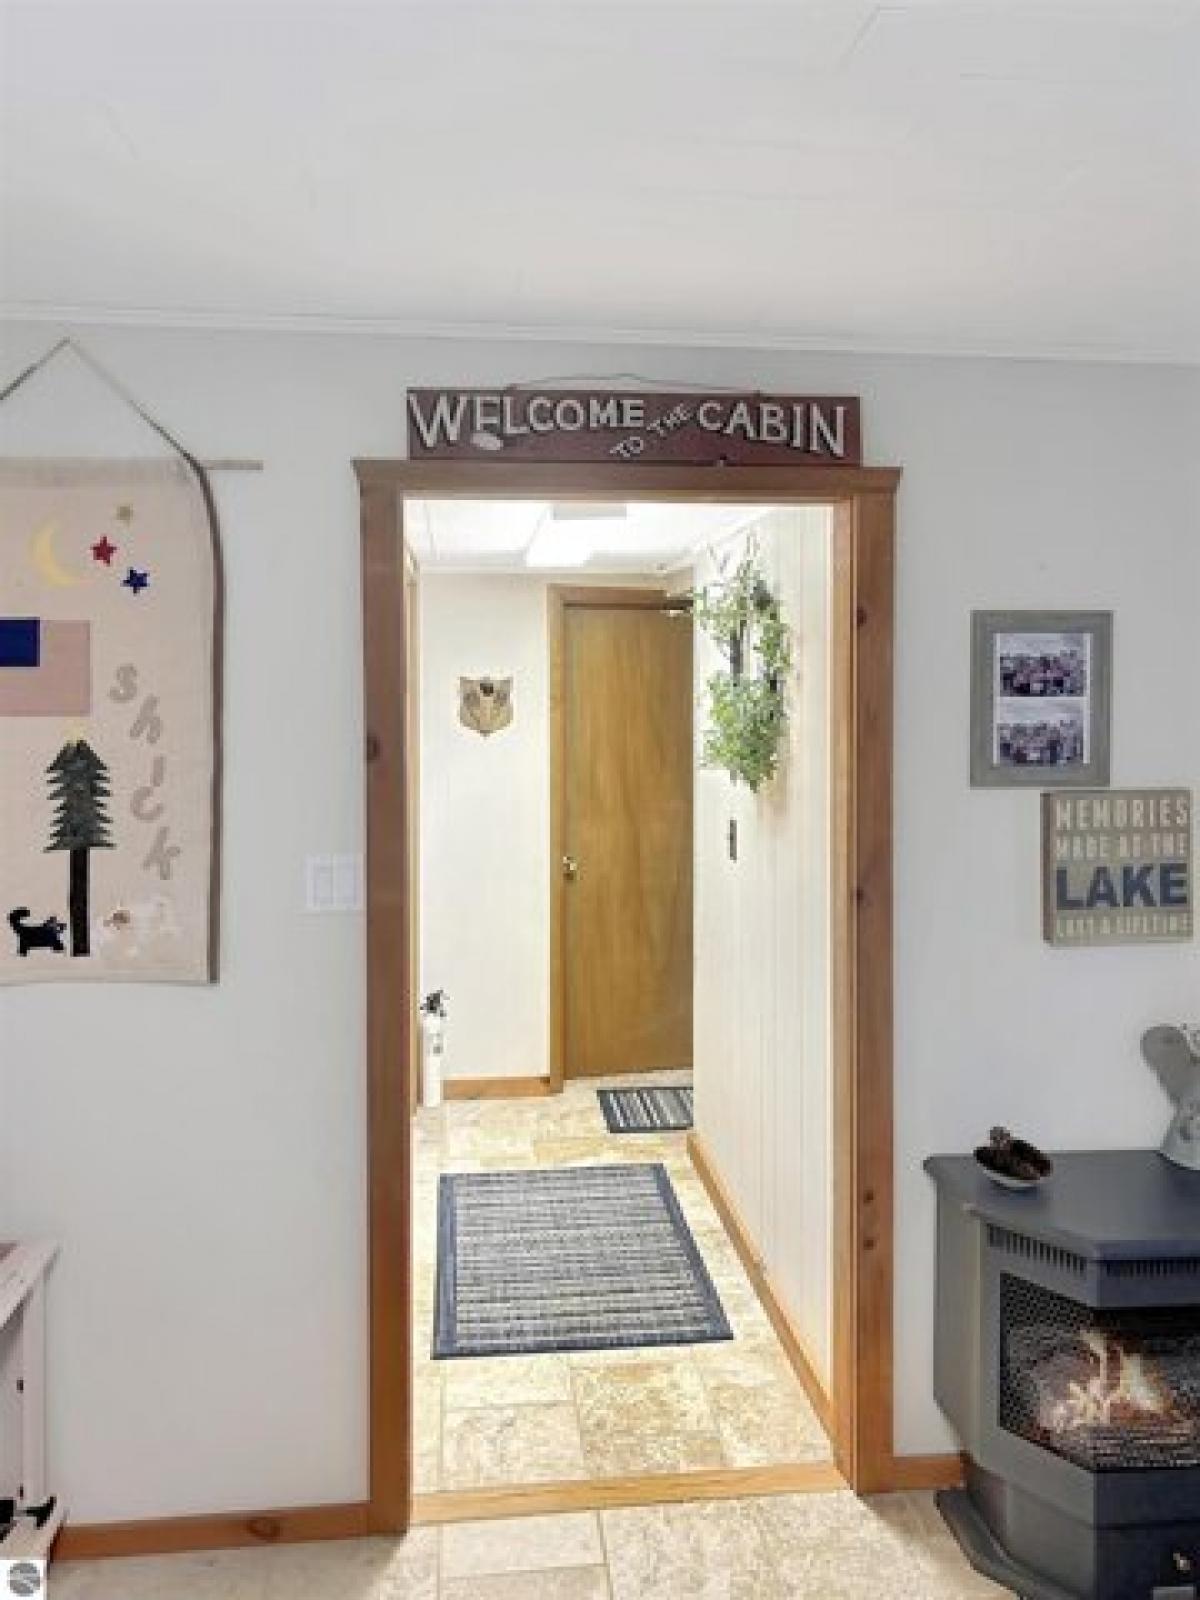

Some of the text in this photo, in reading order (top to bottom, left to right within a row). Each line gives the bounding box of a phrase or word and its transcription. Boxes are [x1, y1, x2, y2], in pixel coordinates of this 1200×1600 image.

[409, 393, 845, 459] WELCOME TO THE CABIN
[1056, 798, 1188, 830] MEMORIES
[1150, 832, 1188, 856] THE
[1056, 863, 1188, 911] LAKE
